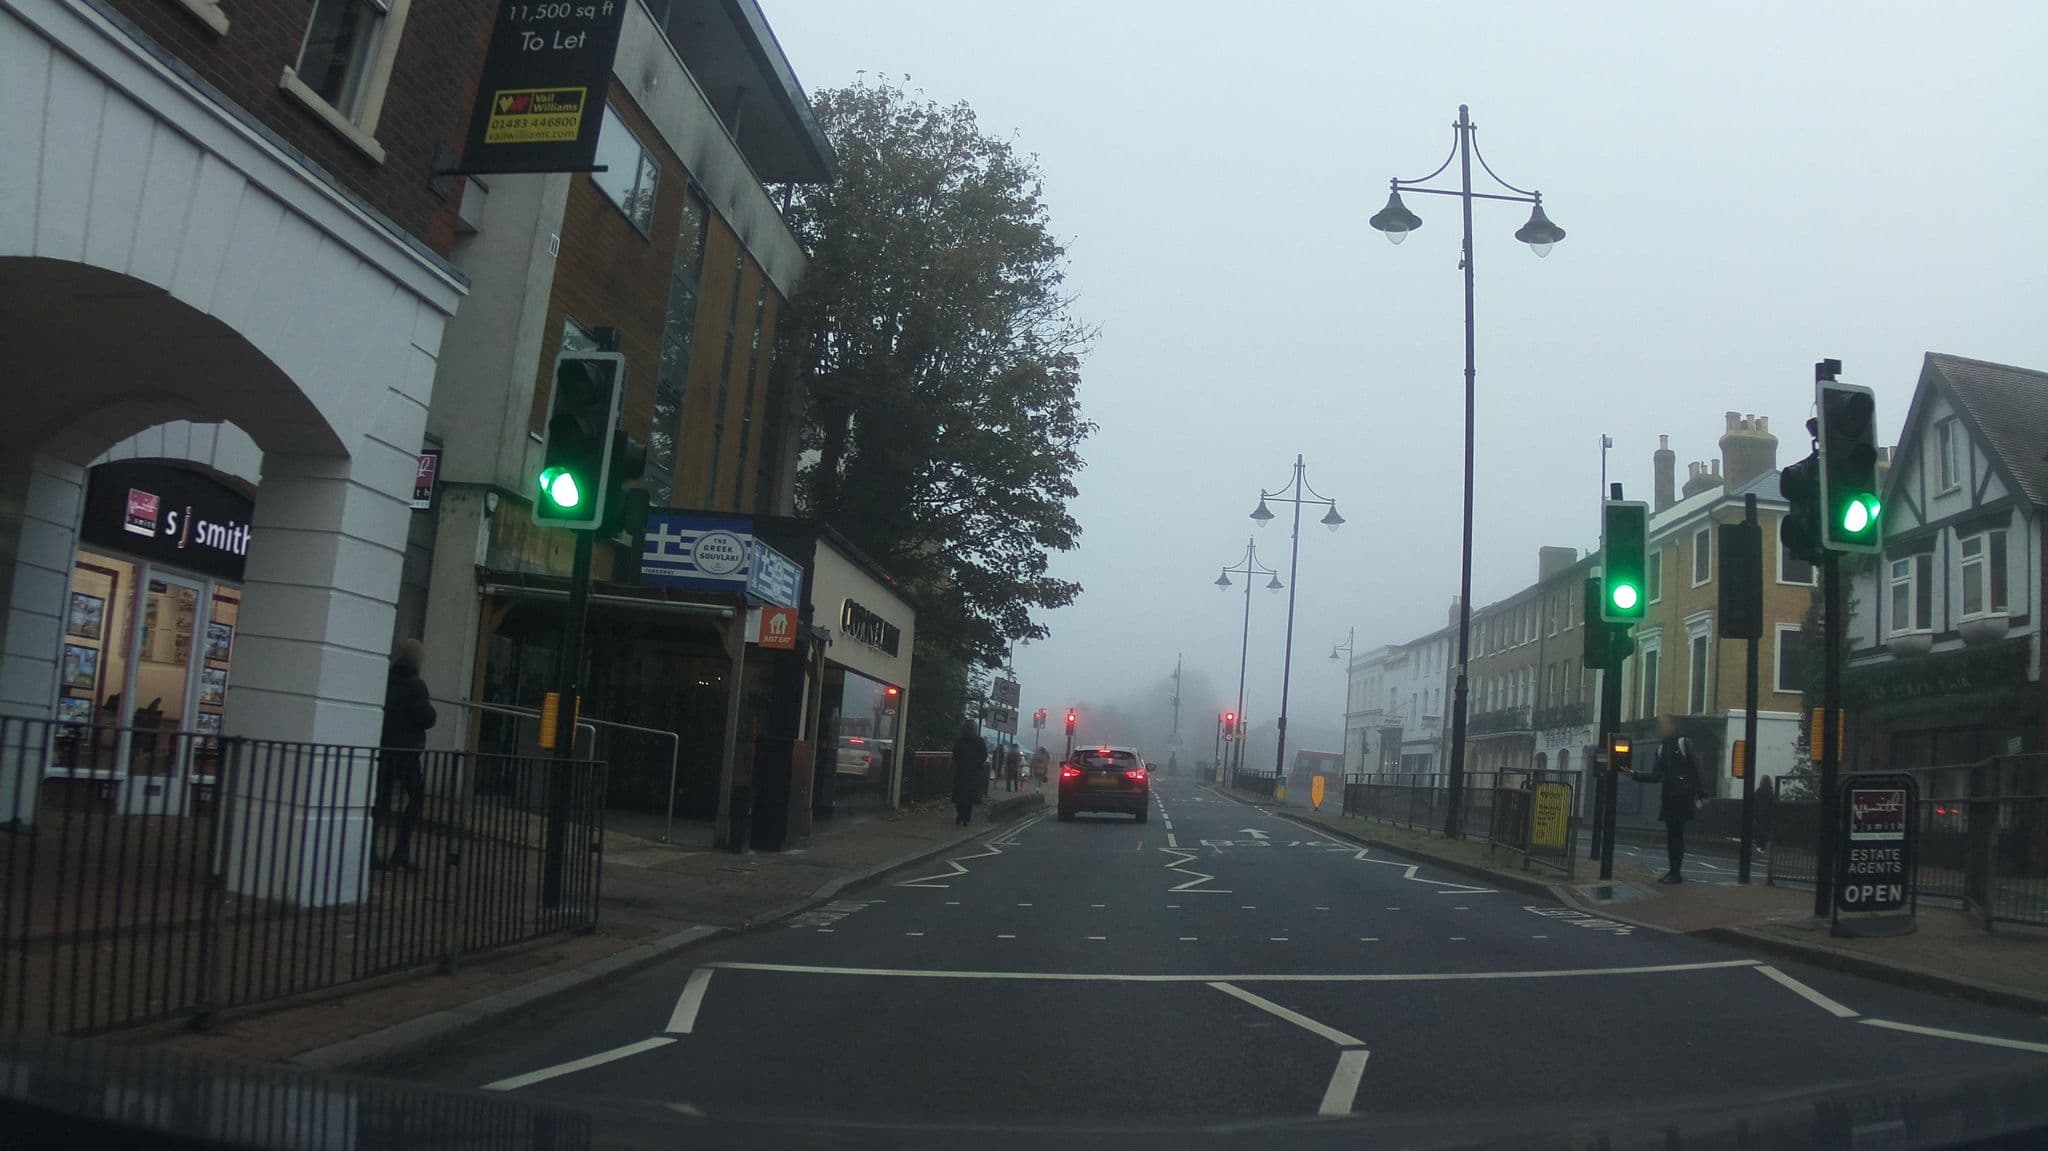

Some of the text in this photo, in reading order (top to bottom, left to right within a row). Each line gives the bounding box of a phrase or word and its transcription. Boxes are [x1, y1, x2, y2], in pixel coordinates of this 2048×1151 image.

[510, 1, 614, 23] 11,500 sq ft
[521, 30, 587, 52] To Let
[534, 102, 578, 113] Williams
[491, 117, 577, 129] 01483 446800
[165, 511, 178, 535] s
[703, 544, 733, 553] GREEK
[699, 552, 739, 562] SOUVLAKI
[763, 635, 779, 643] JUST
[1851, 848, 1901, 861] ESTATE
[1848, 862, 1902, 874] AGENTS
[1845, 885, 1902, 904] OPEN
